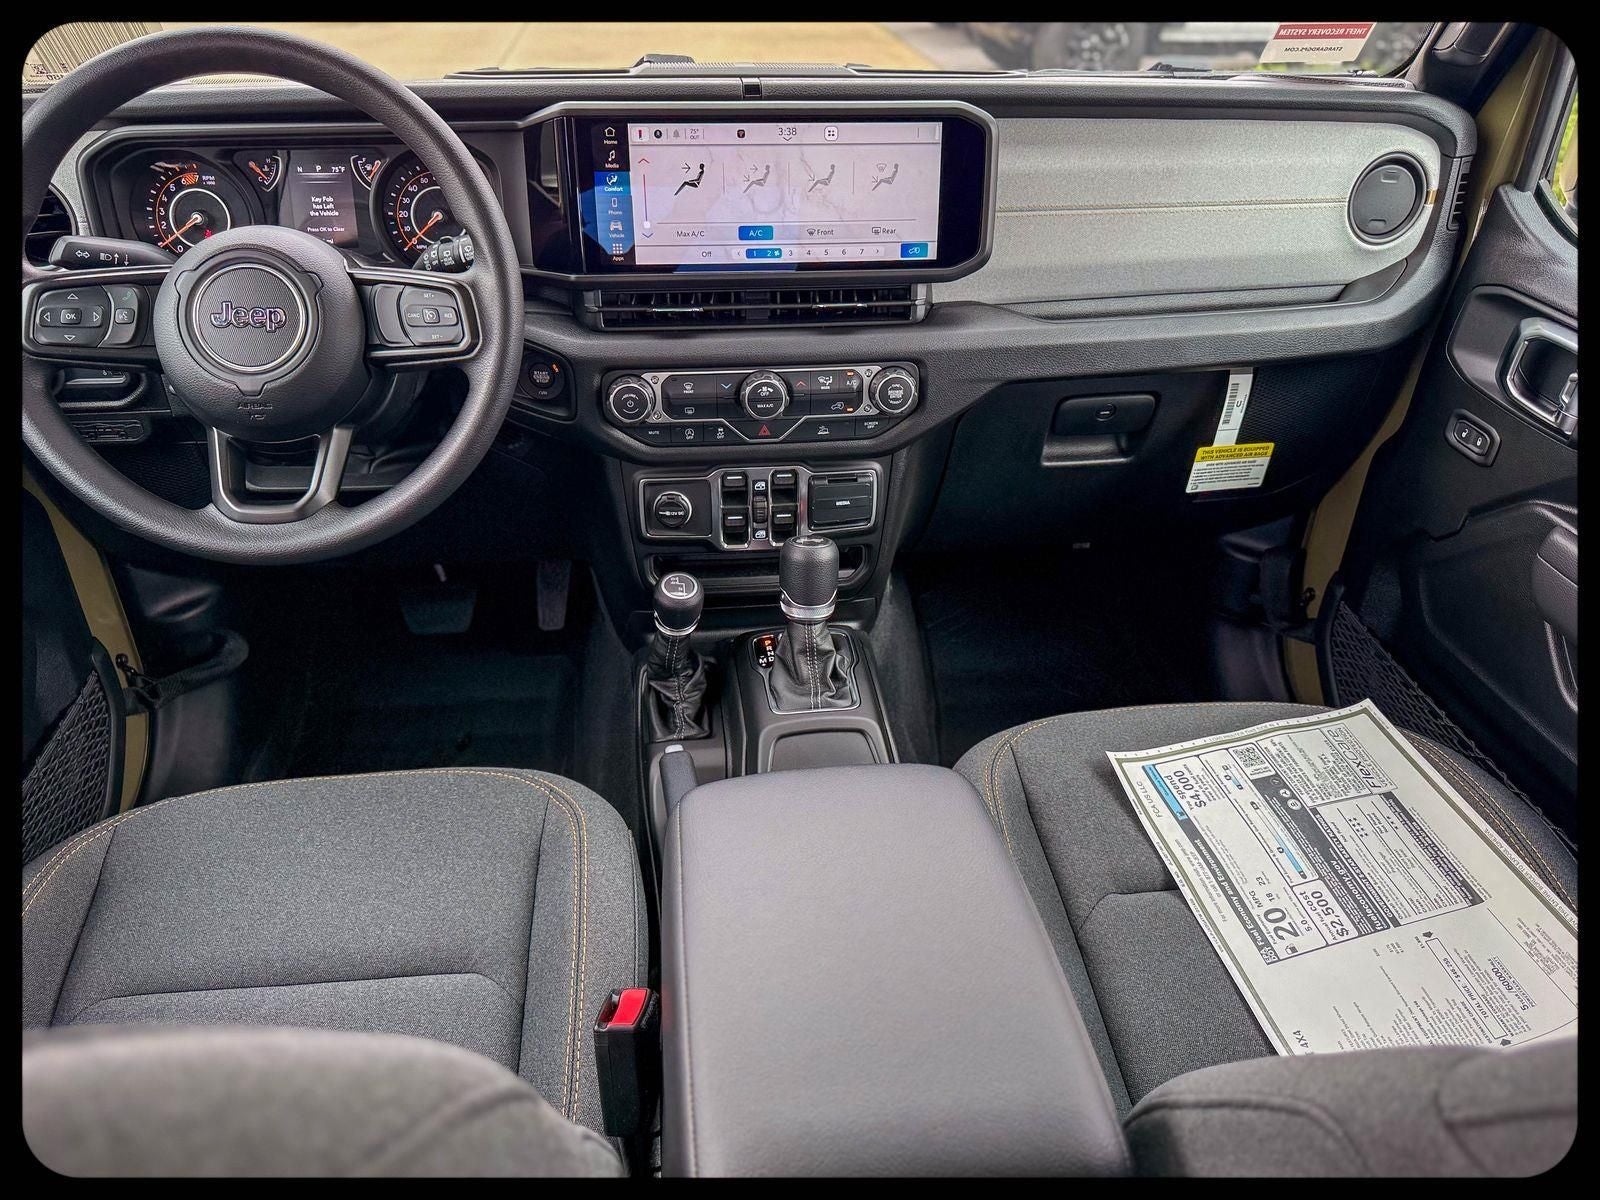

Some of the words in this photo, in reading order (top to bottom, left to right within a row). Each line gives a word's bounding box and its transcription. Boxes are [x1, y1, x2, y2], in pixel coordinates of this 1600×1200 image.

[778, 128, 797, 136] 3:38
[65, 312, 76, 320] OK
[210, 301, 287, 333] Jeep
[1327, 729, 1381, 787] FlexCare
[1182, 764, 1193, 775] costs
[1135, 780, 1147, 793] LLC
[1164, 774, 1186, 799] spend
[1190, 775, 1199, 784] fuel
[1173, 770, 1206, 807] $4,000
[1143, 794, 1154, 803] US
[1150, 804, 1162, 817] FCA
[1313, 814, 1335, 837] RATINGS
[1331, 839, 1350, 858] SAFETY
[1194, 839, 1225, 881] Environment
[1221, 883, 1230, 894] and
[1254, 876, 1266, 886] 23
[1247, 890, 1263, 907] MPG
[1265, 892, 1276, 901] 18
[1299, 891, 1316, 911] cost
[1331, 860, 1385, 929] fueleconomy.gov
[1361, 878, 1394, 916] GOVERNMENT
[1231, 896, 1253, 928] Economy
[1311, 891, 1348, 936] $2,500
[1314, 912, 1325, 922] fuel
[1263, 908, 1298, 939] 20
[1300, 919, 1312, 931] 5.0
[1321, 922, 1338, 940] Annual
[1249, 929, 1265, 944] Fuel
[1259, 949, 1272, 962] EPA
[1266, 946, 1278, 960] DOT
[1475, 1000, 1488, 1018] TOTAL
[1292, 1030, 1308, 1047] 4X4
